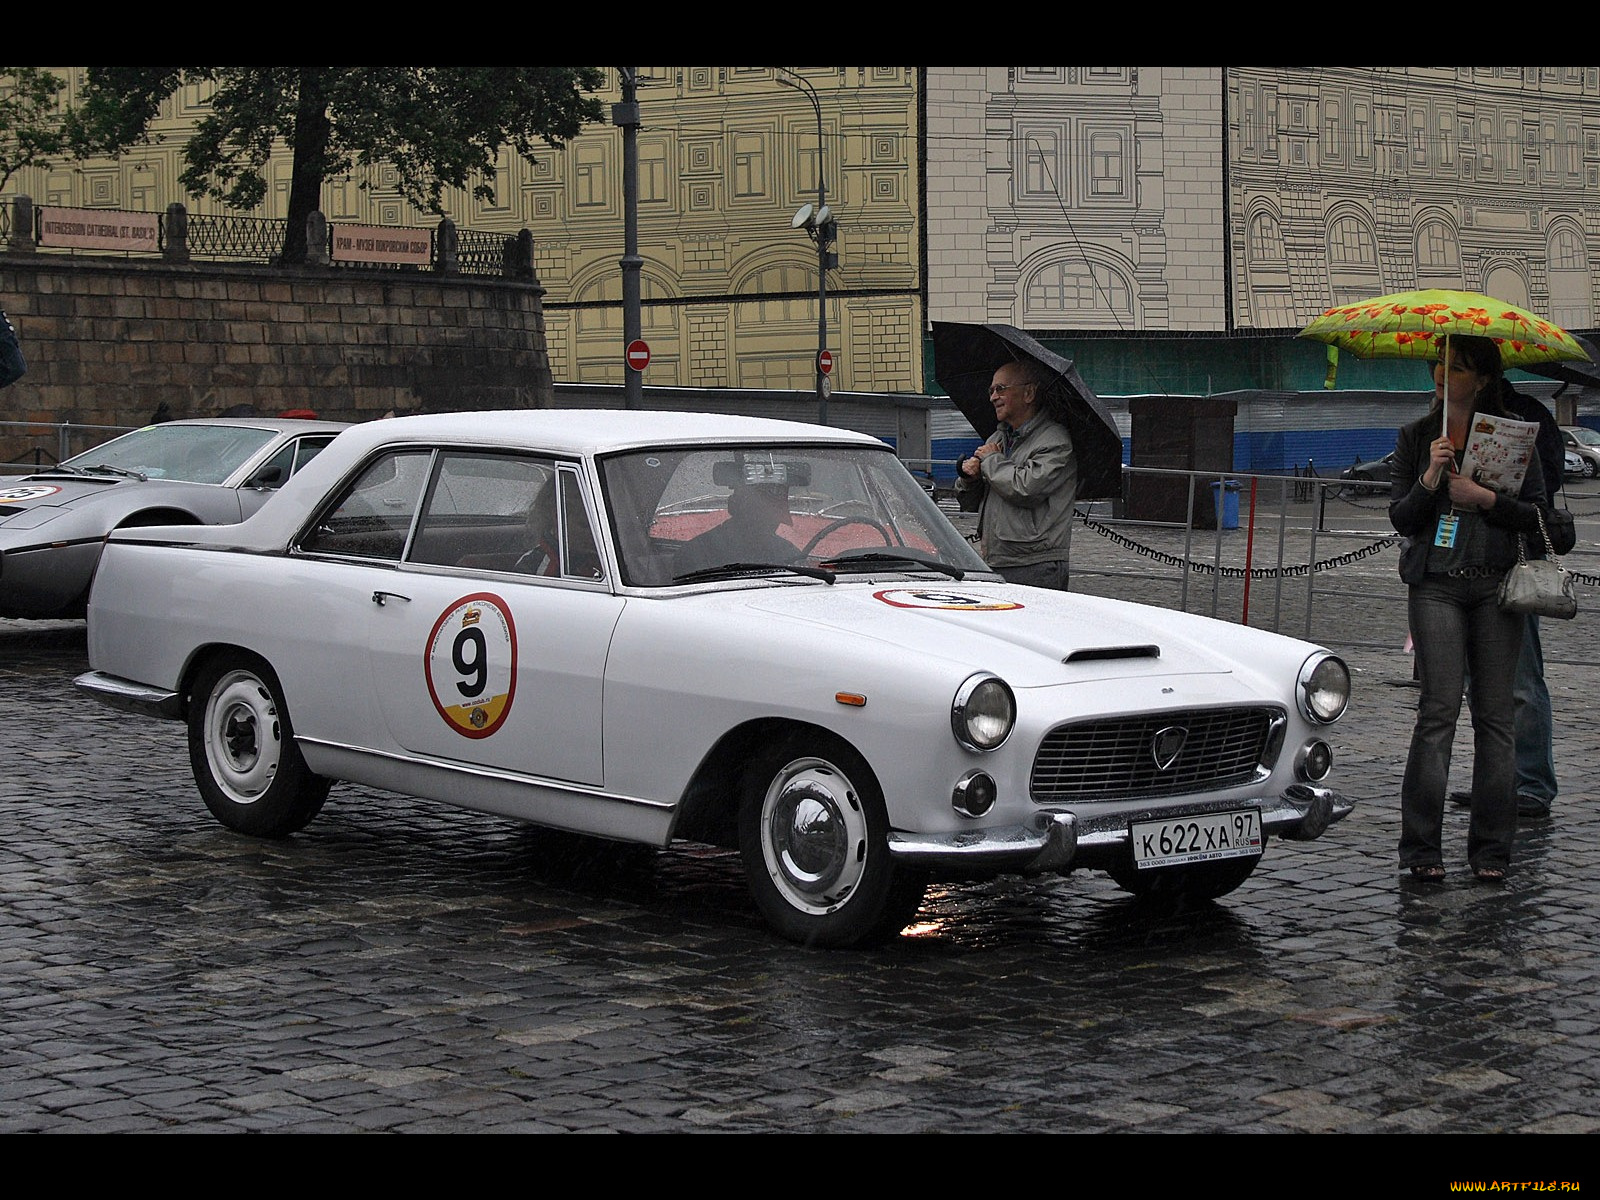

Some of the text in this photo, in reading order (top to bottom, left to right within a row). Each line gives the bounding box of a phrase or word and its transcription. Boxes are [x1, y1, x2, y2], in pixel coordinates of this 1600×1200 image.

[45, 222, 85, 235] INTERCESSION
[87, 224, 119, 238] CATHEDRAL
[336, 238, 352, 250] ХРАМ
[356, 238, 375, 252] МУЗЕЙ
[376, 240, 409, 252] ПОКРОВСКИЙ
[411, 242, 427, 253] СОБОР
[912, 594, 980, 604] 9
[452, 627, 487, 697] 9
[1234, 814, 1253, 837] 97
[1235, 837, 1250, 846] RUS
